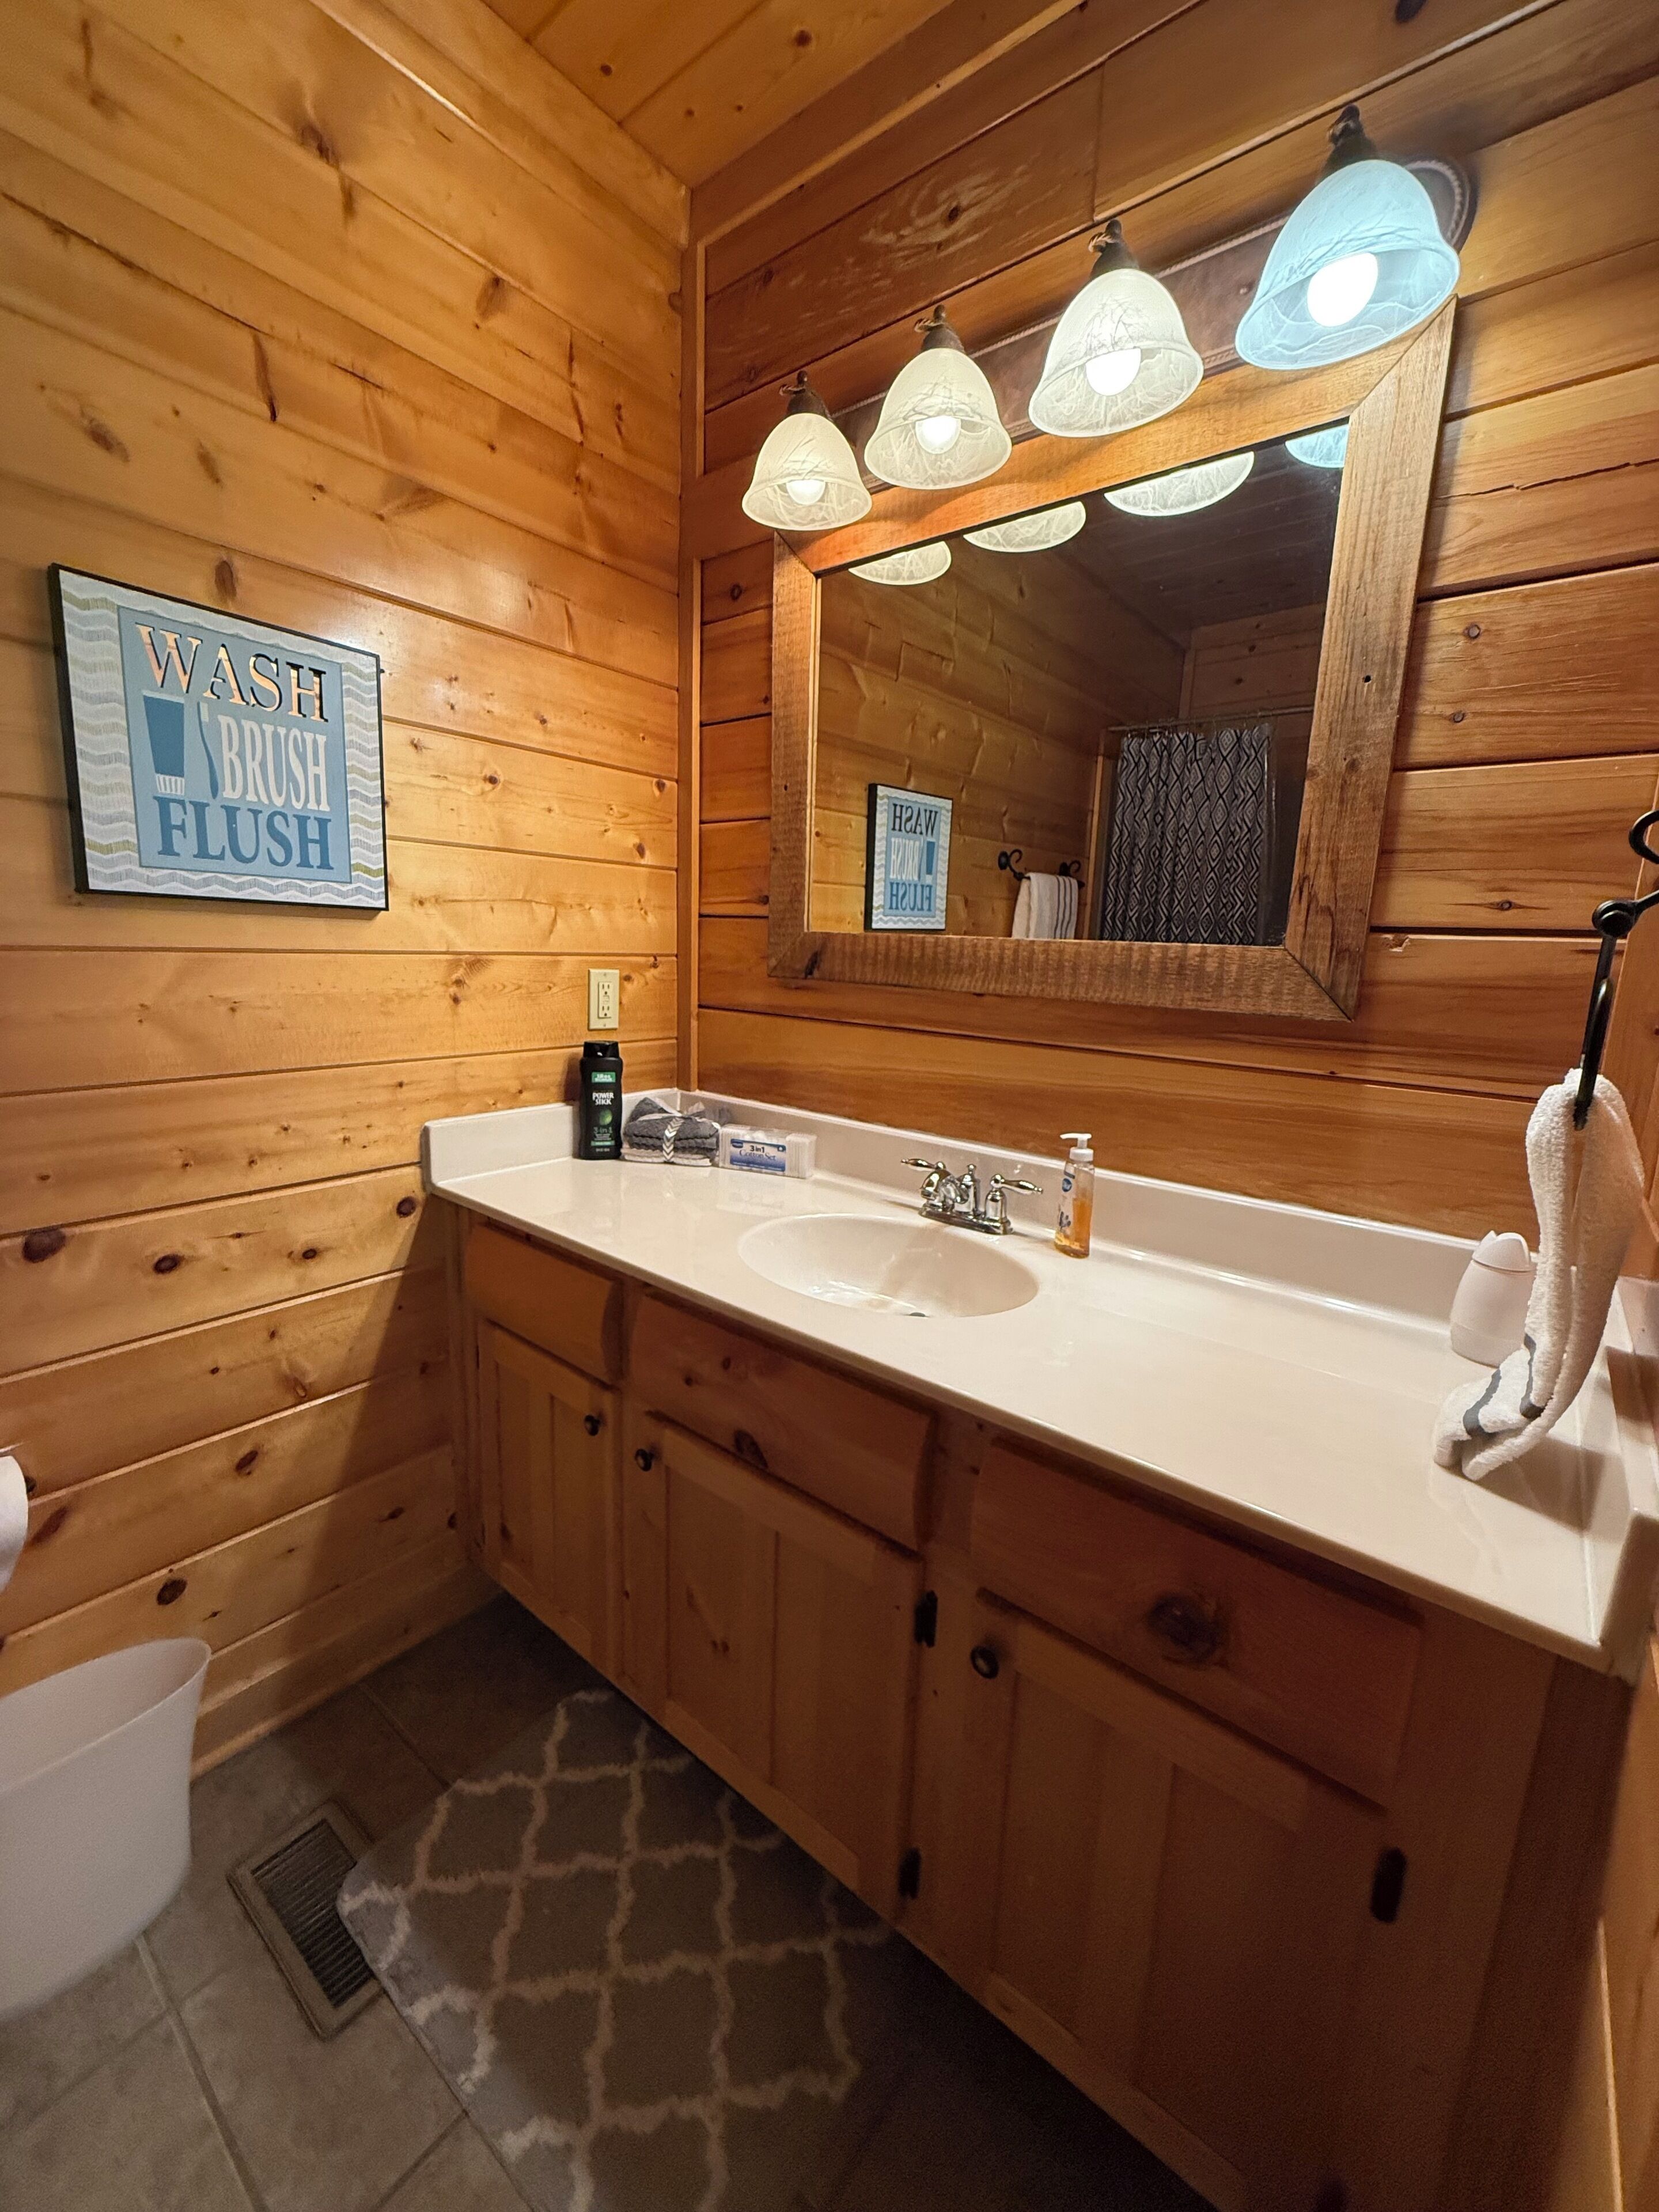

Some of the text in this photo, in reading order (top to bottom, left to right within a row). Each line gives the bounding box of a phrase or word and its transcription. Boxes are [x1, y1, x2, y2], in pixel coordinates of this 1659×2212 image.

[136, 623, 328, 722] WASH
[219, 715, 330, 812] BRUSH
[154, 796, 333, 870] FLUSH
[592, 1092, 614, 1101] POWER
[739, 1149, 764, 1158] Cotton
